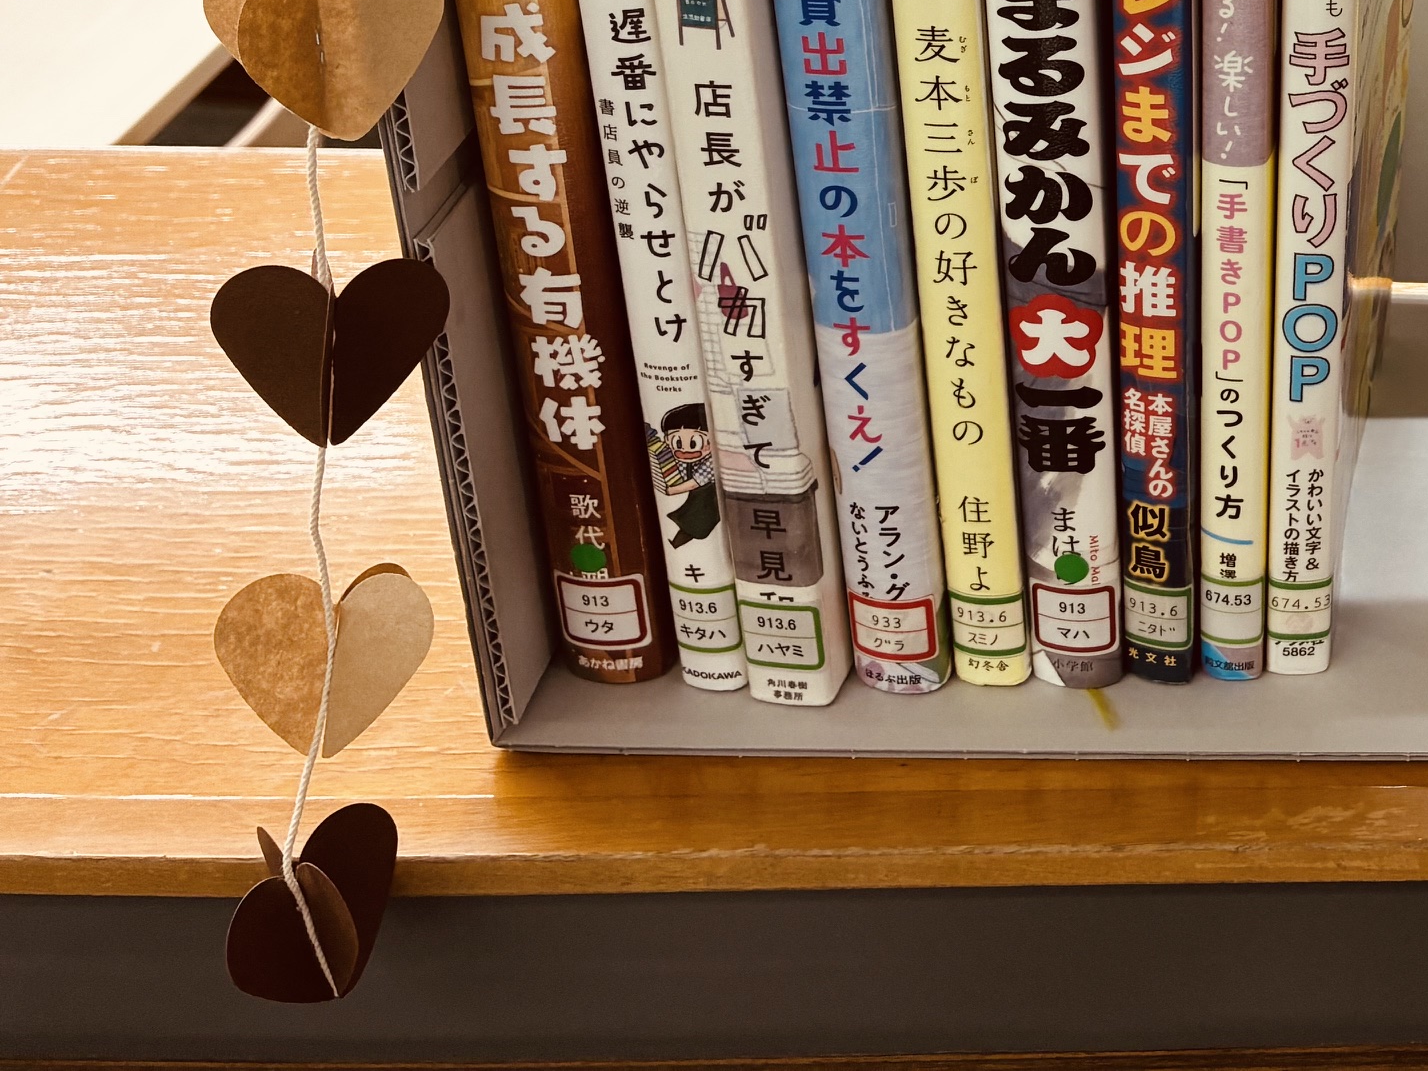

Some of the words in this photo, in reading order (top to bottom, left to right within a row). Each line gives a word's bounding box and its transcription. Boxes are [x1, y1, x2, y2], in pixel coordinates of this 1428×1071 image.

[598, 98, 634, 241] 書店員の逆襲
[609, 7, 687, 343] 遅番にやらせとけ
[1282, 28, 1350, 403] 手づくりPOP
[480, 2, 606, 451] 成長する有機体
[915, 25, 983, 446] 麦本三歩の好きなもの
[694, 80, 773, 469] 店長がバカすぎて
[643, 363, 670, 373] Revenge
[672, 363, 691, 372] of
[654, 373, 698, 382] Bookstore
[656, 385, 682, 393] Clerks
[1123, 389, 1146, 457] 名探偵
[1148, 394, 1173, 497] 本屋さんの
[1282, 469, 1301, 582] イラストの描き方
[1131, 504, 1168, 578] 似鳥
[685, 564, 705, 582] キ
[582, 595, 609, 607] 913
[1205, 590, 1252, 606] 674.53
[1271, 594, 1331, 610] 674.53
[679, 599, 717, 614] 913.6
[1059, 601, 1085, 614] 913
[1129, 597, 1178, 617] 913.6
[872, 615, 901, 629] 933
[957, 606, 1007, 624] 913.6
[585, 619, 614, 634] ウタ
[757, 616, 797, 631] 913.6
[680, 624, 726, 640] キタハ
[967, 632, 1000, 646] スミノ
[1057, 627, 1090, 639] マハ
[757, 643, 804, 657] ハヤミ
[874, 637, 905, 652] グラ
[1282, 646, 1315, 656] 5862
[578, 655, 643, 670] あかね書房
[1128, 647, 1177, 666] 光文社
[682, 666, 742, 679] KADOKAWA
[968, 659, 1009, 672] 幻冬舎
[1053, 660, 1093, 672] 小学館
[767, 678, 808, 690] 角川春樹
[774, 690, 803, 701] 事務所
